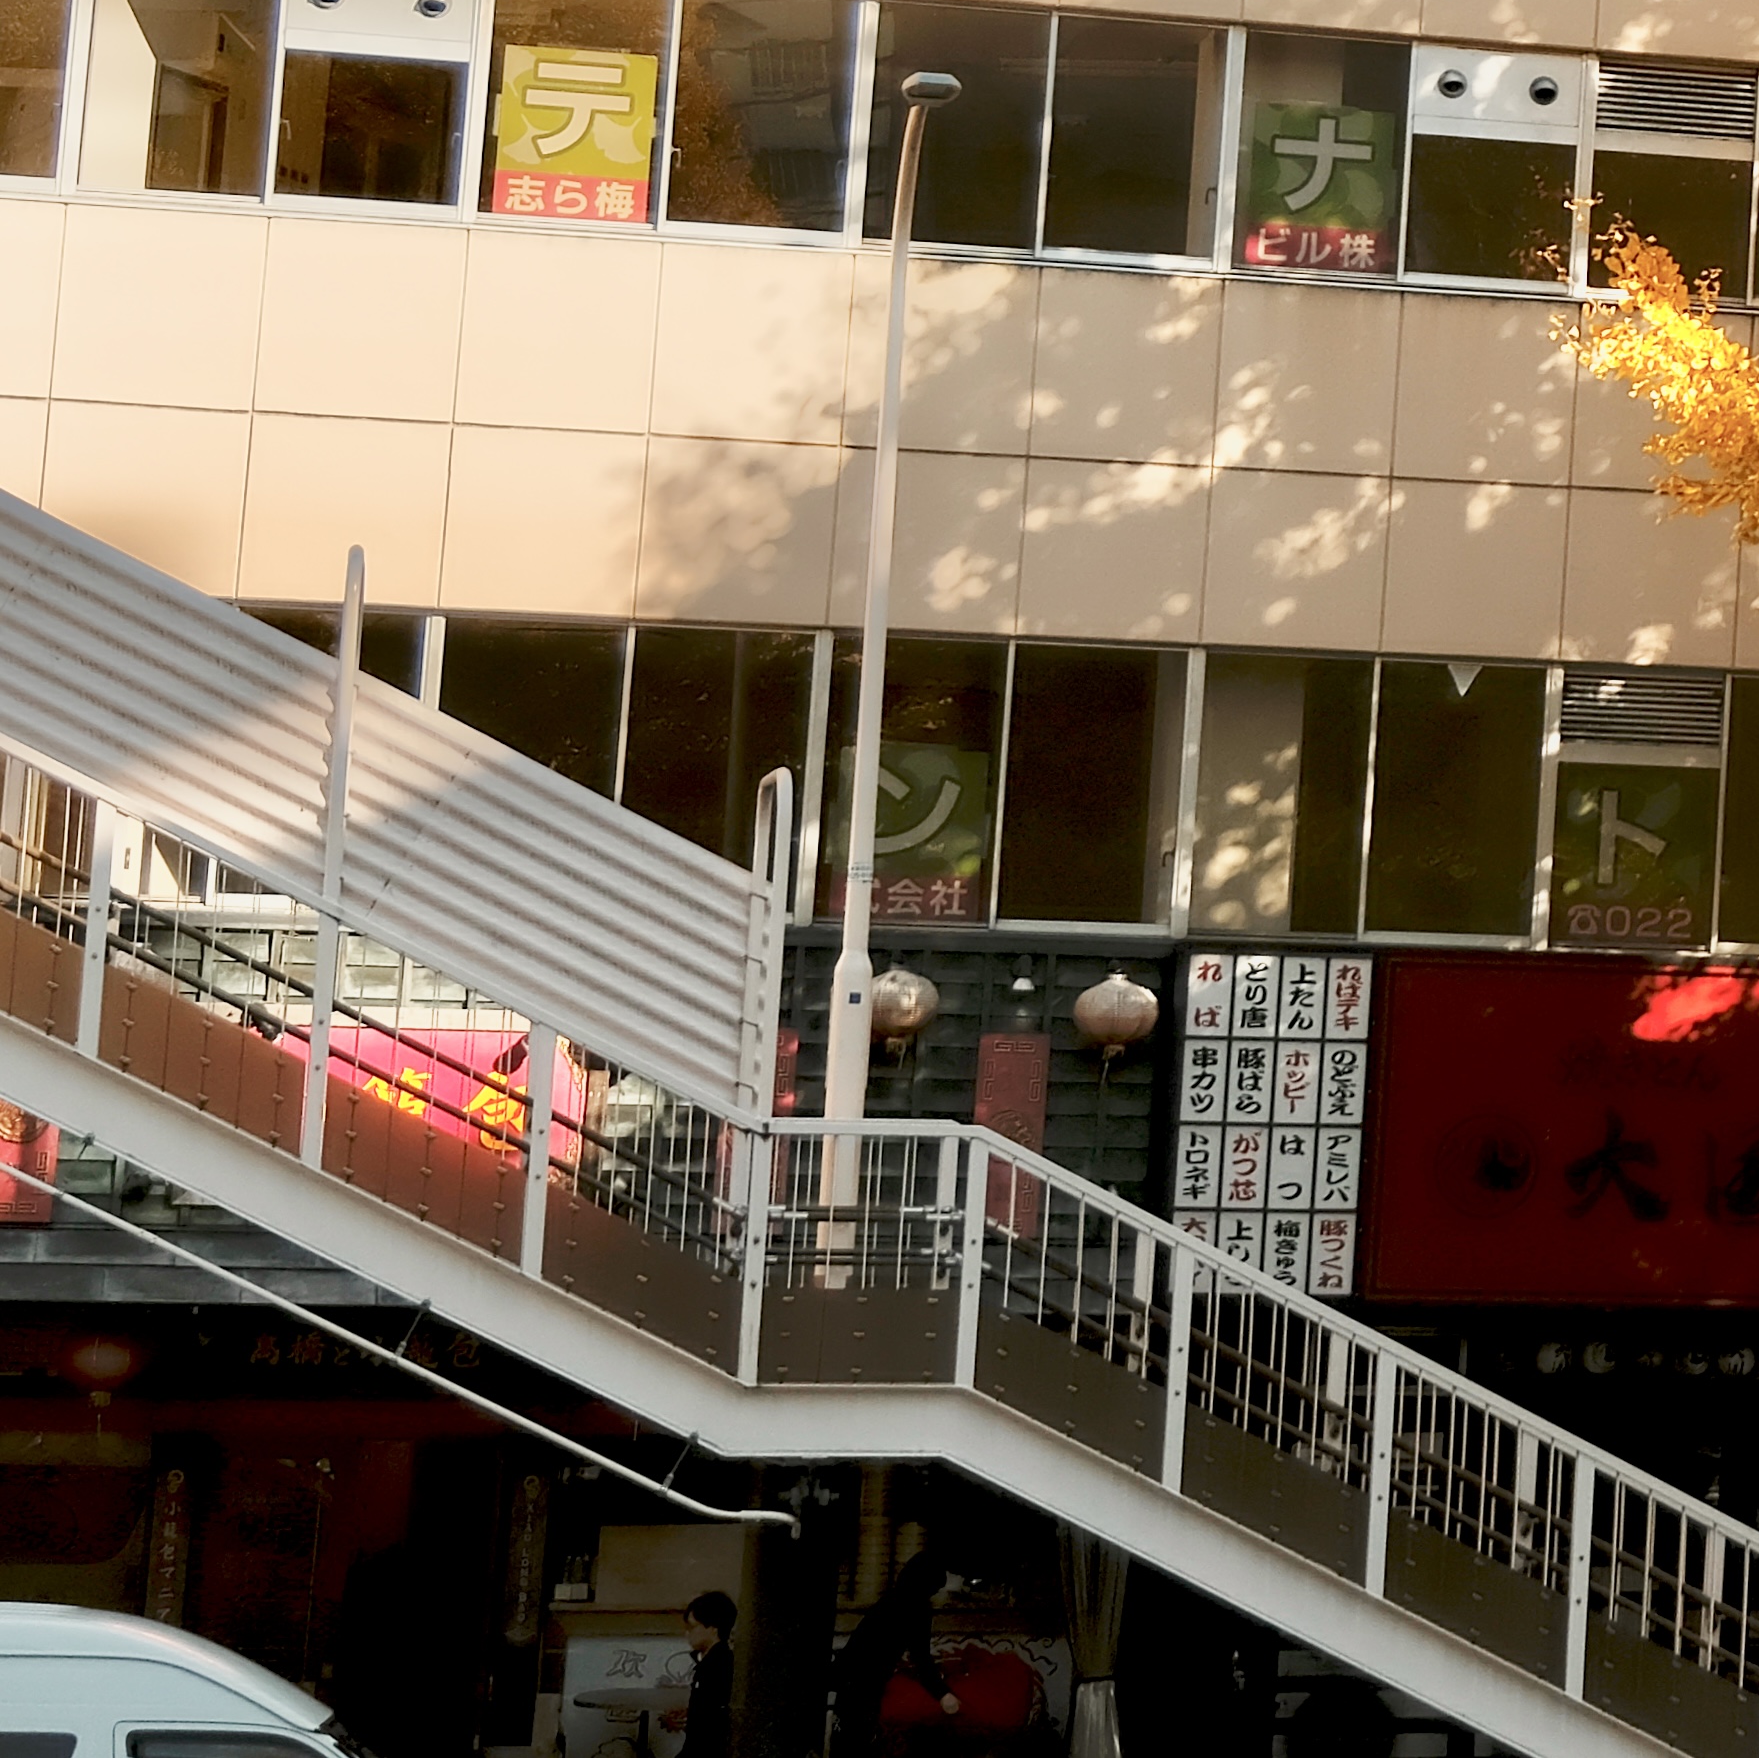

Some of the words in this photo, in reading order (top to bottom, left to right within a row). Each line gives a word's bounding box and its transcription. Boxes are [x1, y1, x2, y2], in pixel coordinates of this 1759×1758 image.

[524, 59, 632, 159] テ
[504, 176, 636, 221] 志ら梅
[1272, 117, 1374, 213] ナ
[1255, 225, 1378, 269] ビル株
[1598, 789, 1667, 885] ト
[1604, 904, 1693, 939] 022
[1241, 962, 1268, 1030] とり唐
[1288, 963, 1314, 1030] 上たん
[1191, 1046, 1218, 1113] 串カツ
[1236, 1047, 1266, 1114] 豚ばら
[1182, 1131, 1210, 1201] トロネギ
[1323, 1134, 1352, 1202] アミレバ
[1317, 1219, 1348, 1289] 豚つくね
